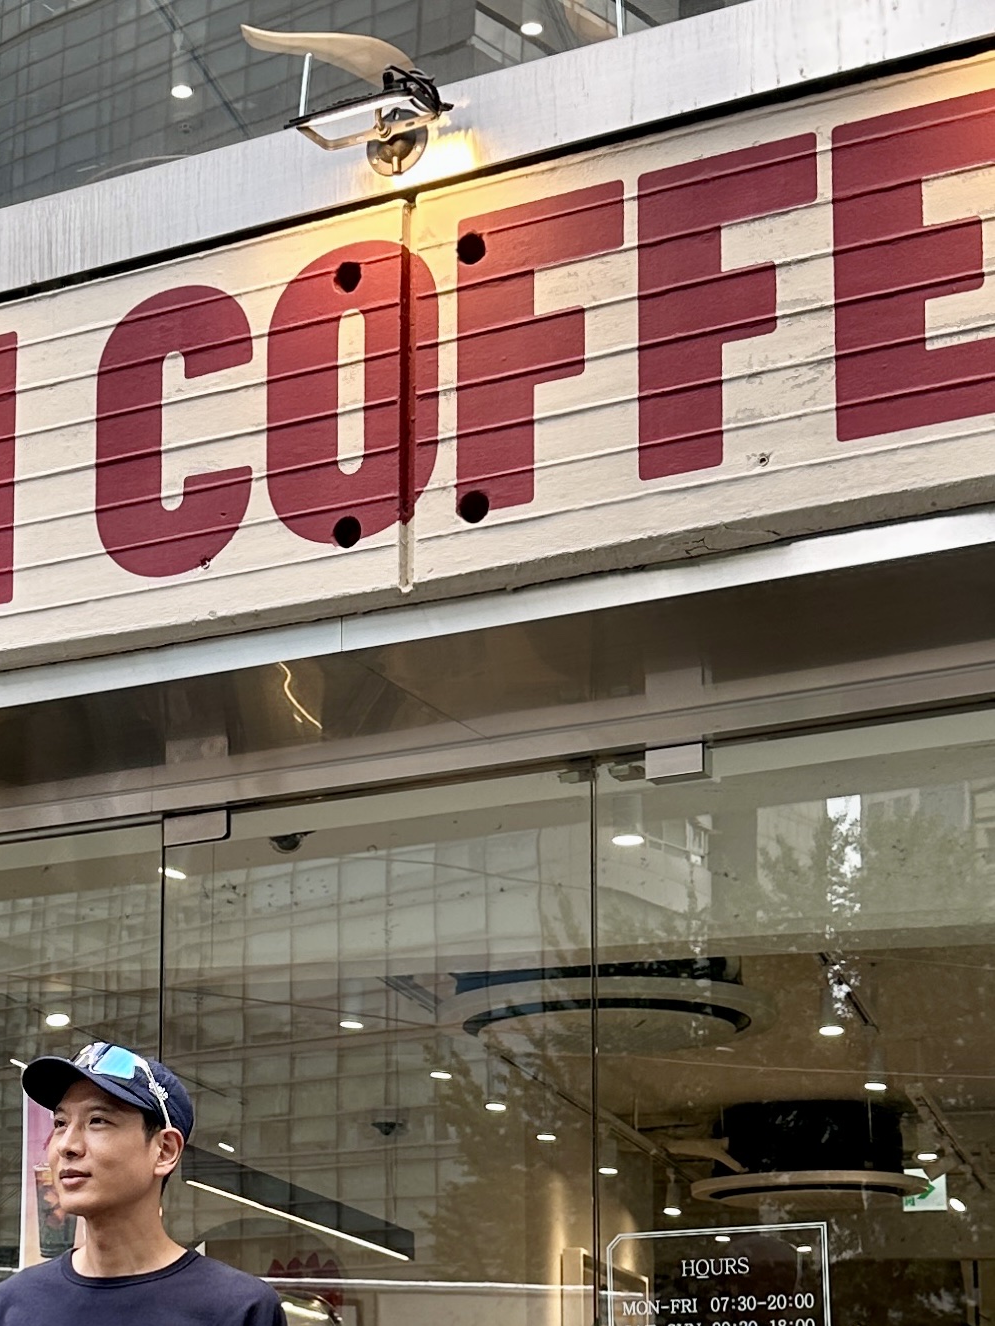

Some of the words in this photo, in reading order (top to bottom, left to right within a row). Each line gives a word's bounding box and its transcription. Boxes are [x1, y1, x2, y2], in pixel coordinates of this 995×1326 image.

[96, 88, 995, 578] COFFE
[681, 1257, 750, 1279] HOURS
[622, 1298, 698, 1317] MON-FRI
[710, 1293, 815, 1313] 07:30-20:00
